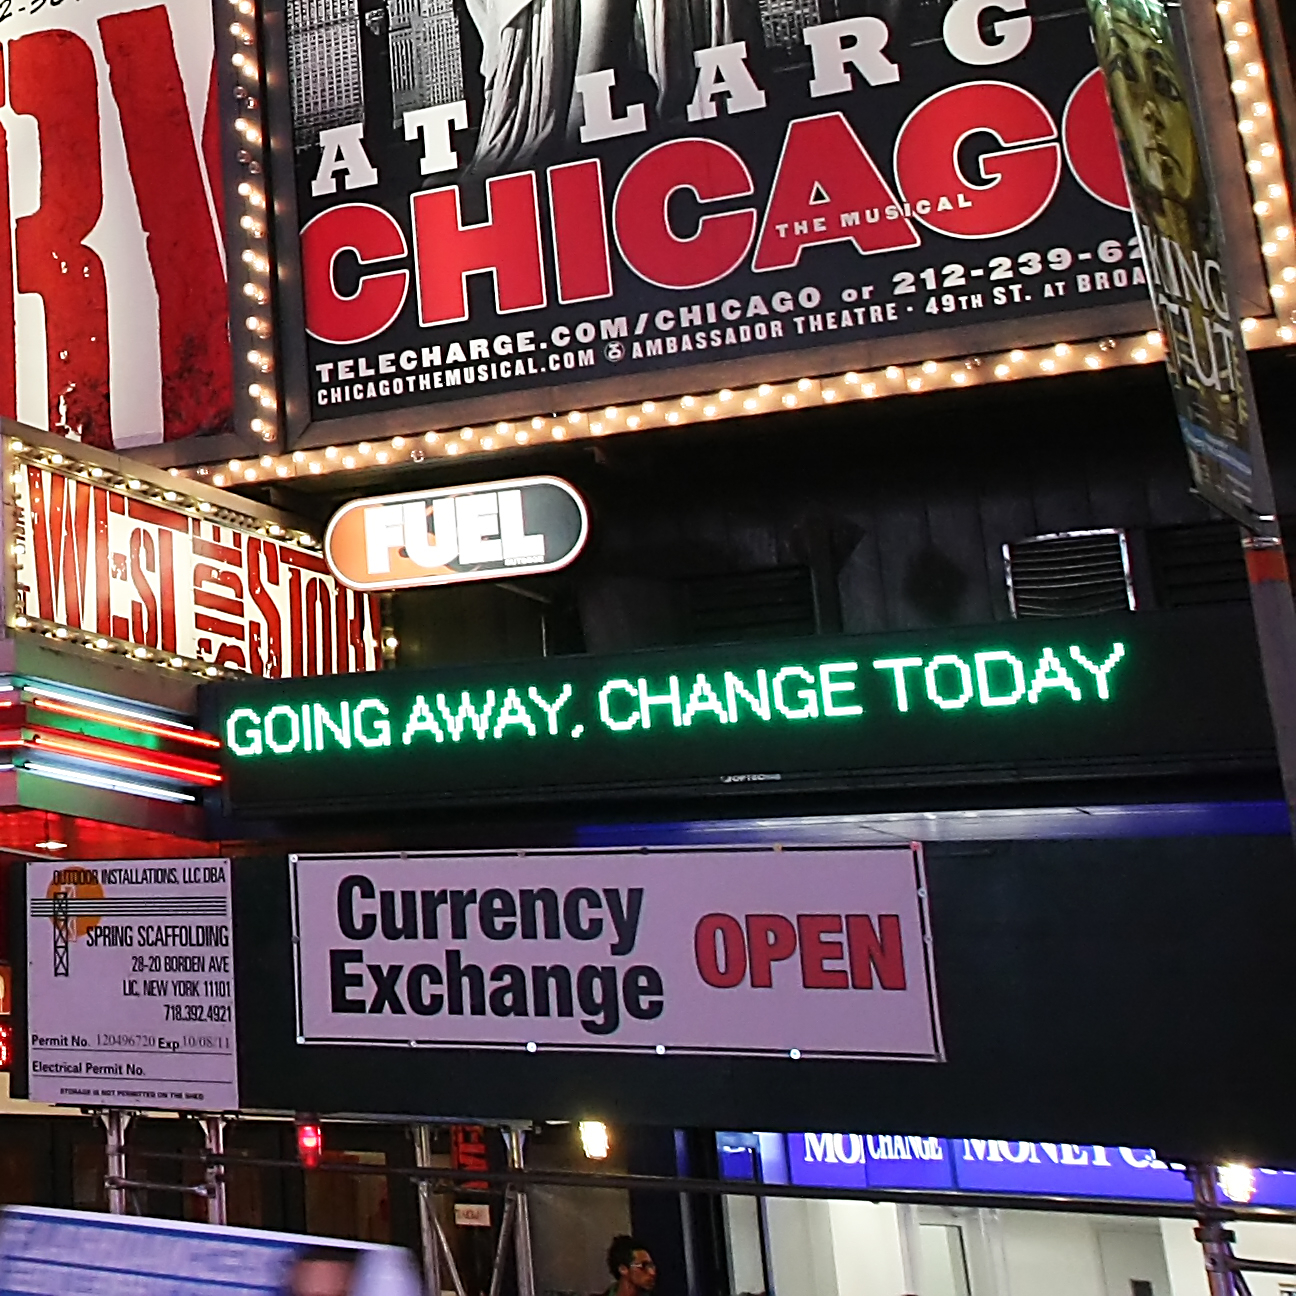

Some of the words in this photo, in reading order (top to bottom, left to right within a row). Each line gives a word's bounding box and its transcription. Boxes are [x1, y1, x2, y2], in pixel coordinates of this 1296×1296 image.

[311, 100, 469, 197] AT
[775, 218, 836, 240] THE
[840, 192, 974, 227] MUSICAL
[841, 284, 874, 303] or
[317, 349, 596, 406] CHICAGOTHEMUSICAL.COM
[631, 318, 785, 360] AMBASSADOR
[793, 302, 898, 336] THEATRE
[925, 293, 983, 316] 49TH
[992, 284, 1032, 306] ST.
[1043, 280, 1067, 299] AT
[25, 464, 190, 657] WEST
[364, 489, 547, 576] FUEL
[224, 699, 391, 759] GOING
[401, 683, 588, 747] AWAY,
[598, 661, 863, 733] CHANGE
[872, 642, 1126, 711] TODAY
[182, 867, 201, 884] LLC
[203, 866, 226, 884] DBA
[86, 925, 134, 948] SPRING
[137, 924, 230, 948] SCAFFOLDING
[335, 873, 645, 957] Currency
[164, 955, 206, 973] BORDEN
[208, 955, 231, 973] AVE
[692, 911, 908, 991] OPEN
[143, 979, 168, 997] NEW
[171, 980, 200, 997] YORK
[327, 947, 665, 1036] Exchange
[31, 1034, 69, 1047] Permit
[71, 1035, 91, 1048] No.
[158, 1037, 181, 1052] Exp
[32, 1060, 83, 1074] Electrical
[85, 1061, 124, 1076] Permit
[126, 1063, 146, 1077] No.
